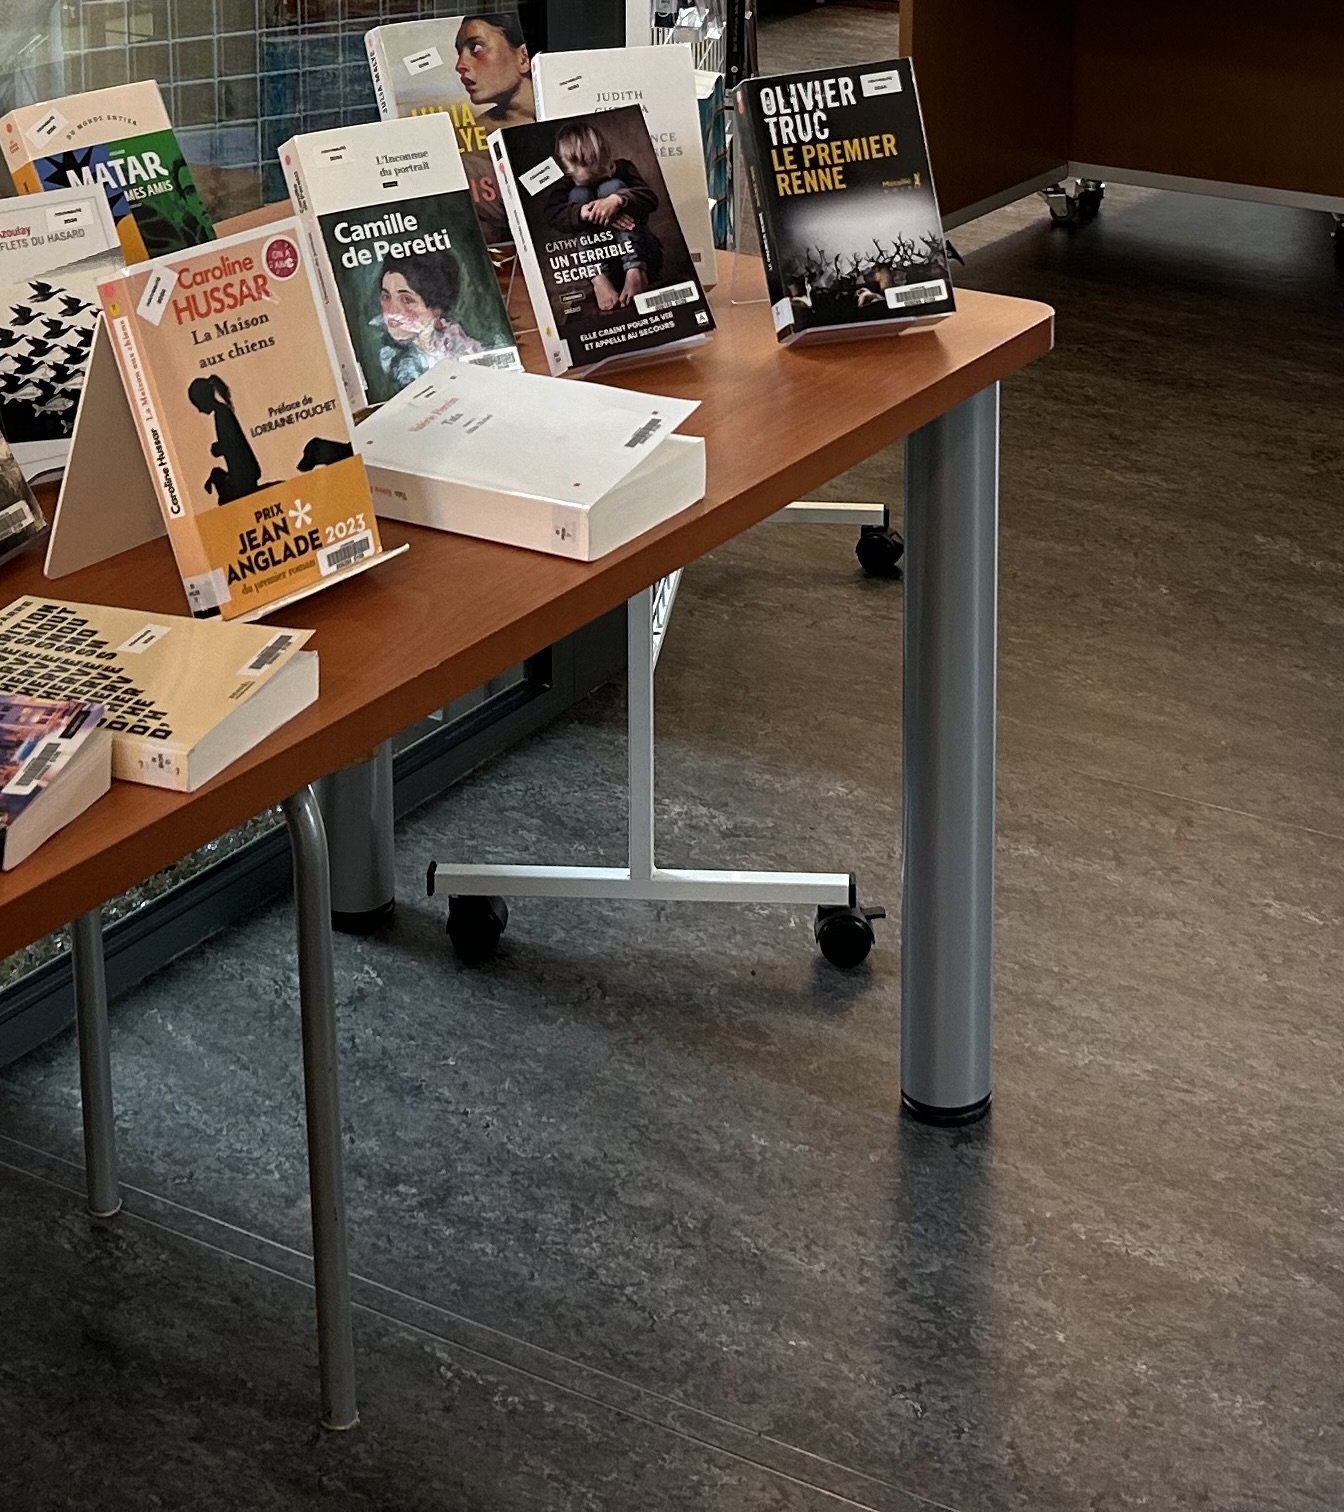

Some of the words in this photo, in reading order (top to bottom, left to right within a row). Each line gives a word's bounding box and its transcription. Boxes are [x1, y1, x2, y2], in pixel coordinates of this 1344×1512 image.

[595, 89, 644, 103] JUDITH
[759, 76, 857, 117] OLIVIER
[763, 110, 830, 146] TRUC
[375, 148, 430, 166] L'Inconnue
[379, 164, 393, 177] du
[393, 160, 431, 178] portrait
[770, 146, 798, 172] LE
[801, 133, 899, 168] PREMIER
[65, 149, 171, 190] MATAR
[775, 166, 848, 197] RENNE
[123, 184, 148, 203] MES
[146, 178, 175, 197] AMIS
[31, 235, 47, 248] DU
[46, 227, 87, 244] HASARD
[333, 211, 420, 245] Camille
[545, 237, 580, 254] CATHY
[578, 230, 615, 246] GLASS
[341, 246, 374, 270] de
[373, 227, 453, 263] Peretti
[549, 254, 571, 271] UN
[571, 240, 636, 266] TERRIBLE
[176, 253, 254, 290] Caroline
[553, 262, 604, 285] SECRET
[171, 272, 273, 325] HUSSAR
[191, 328, 213, 346] La
[214, 311, 270, 340] Maison
[580, 330, 598, 343] ELLE
[627, 317, 649, 331] POUR
[649, 315, 660, 325] SA
[660, 310, 674, 322] VIE
[583, 342, 596, 352] ET
[595, 334, 626, 350] APPELLE
[626, 331, 639, 341] AU
[638, 320, 676, 339] SECOURS
[198, 352, 226, 369] aux
[227, 334, 277, 361] chiens
[248, 414, 297, 439] LORRAINE
[292, 398, 338, 424] FOUCHET
[267, 398, 302, 419] Préface
[301, 394, 314, 406] de
[150, 426, 169, 469] Hussar
[163, 464, 182, 515] Caroline
[253, 501, 285, 524] PRIX
[226, 527, 324, 586] ANGLADE
[324, 511, 367, 544] 2023
[237, 516, 292, 555] JEAN
[14, 606, 78, 647] SNOUT
[34, 617, 89, 651] SNOU
[54, 628, 99, 654] SNO
[74, 639, 110, 657] SN
[94, 650, 119, 661] S
[104, 698, 156, 731] D'HE
[126, 709, 168, 736] D'H
[147, 721, 174, 740] D'
